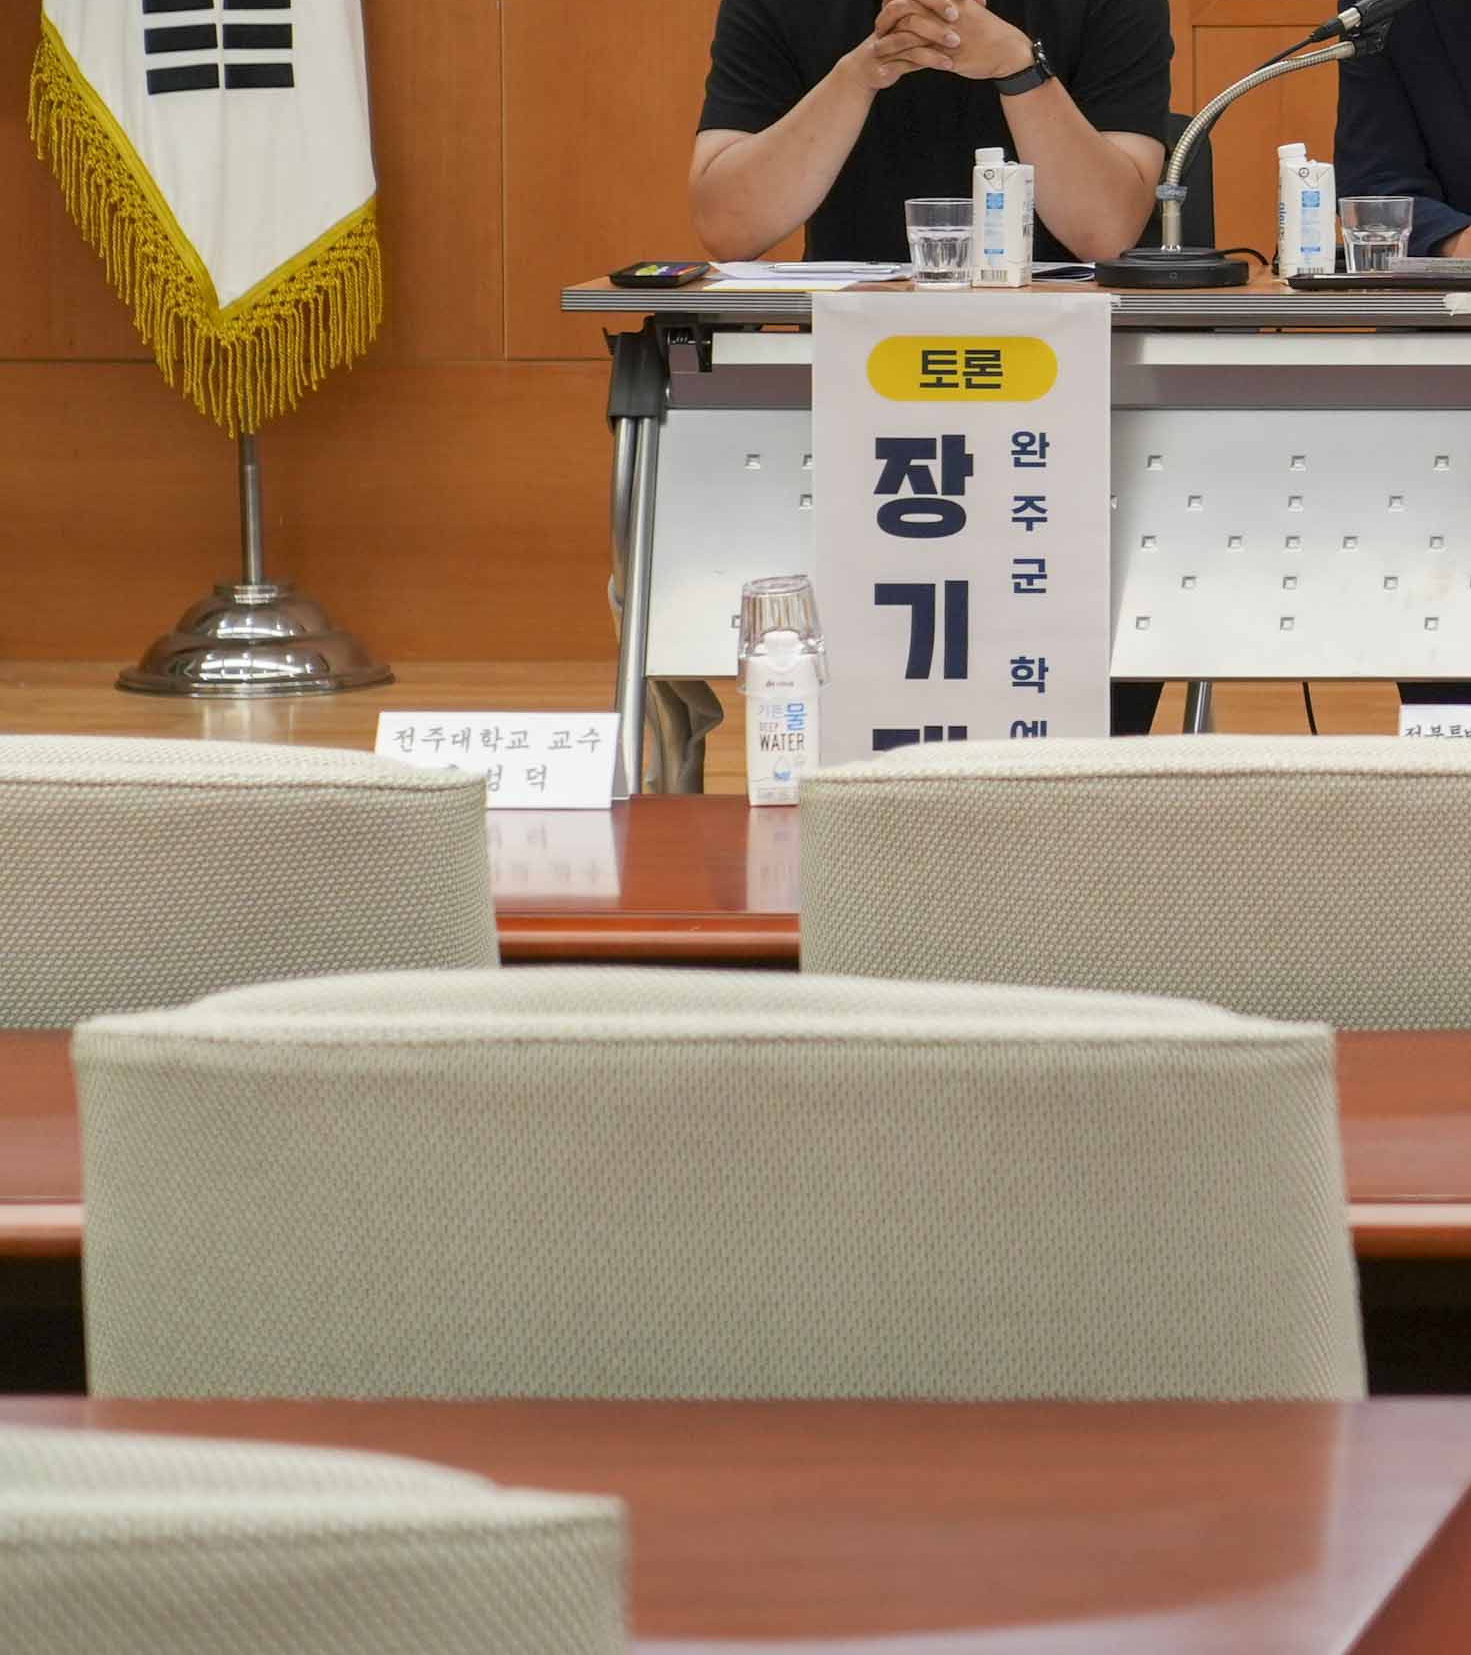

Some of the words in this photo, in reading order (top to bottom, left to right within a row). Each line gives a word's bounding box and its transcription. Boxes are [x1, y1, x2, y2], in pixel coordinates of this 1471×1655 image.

[920, 350, 1003, 389] 토론
[1011, 432, 1049, 593] 완주군
[873, 435, 973, 751] 장기
[394, 727, 529, 753] 전주대학교
[548, 728, 601, 753] 교수
[760, 733, 805, 752] WATER
